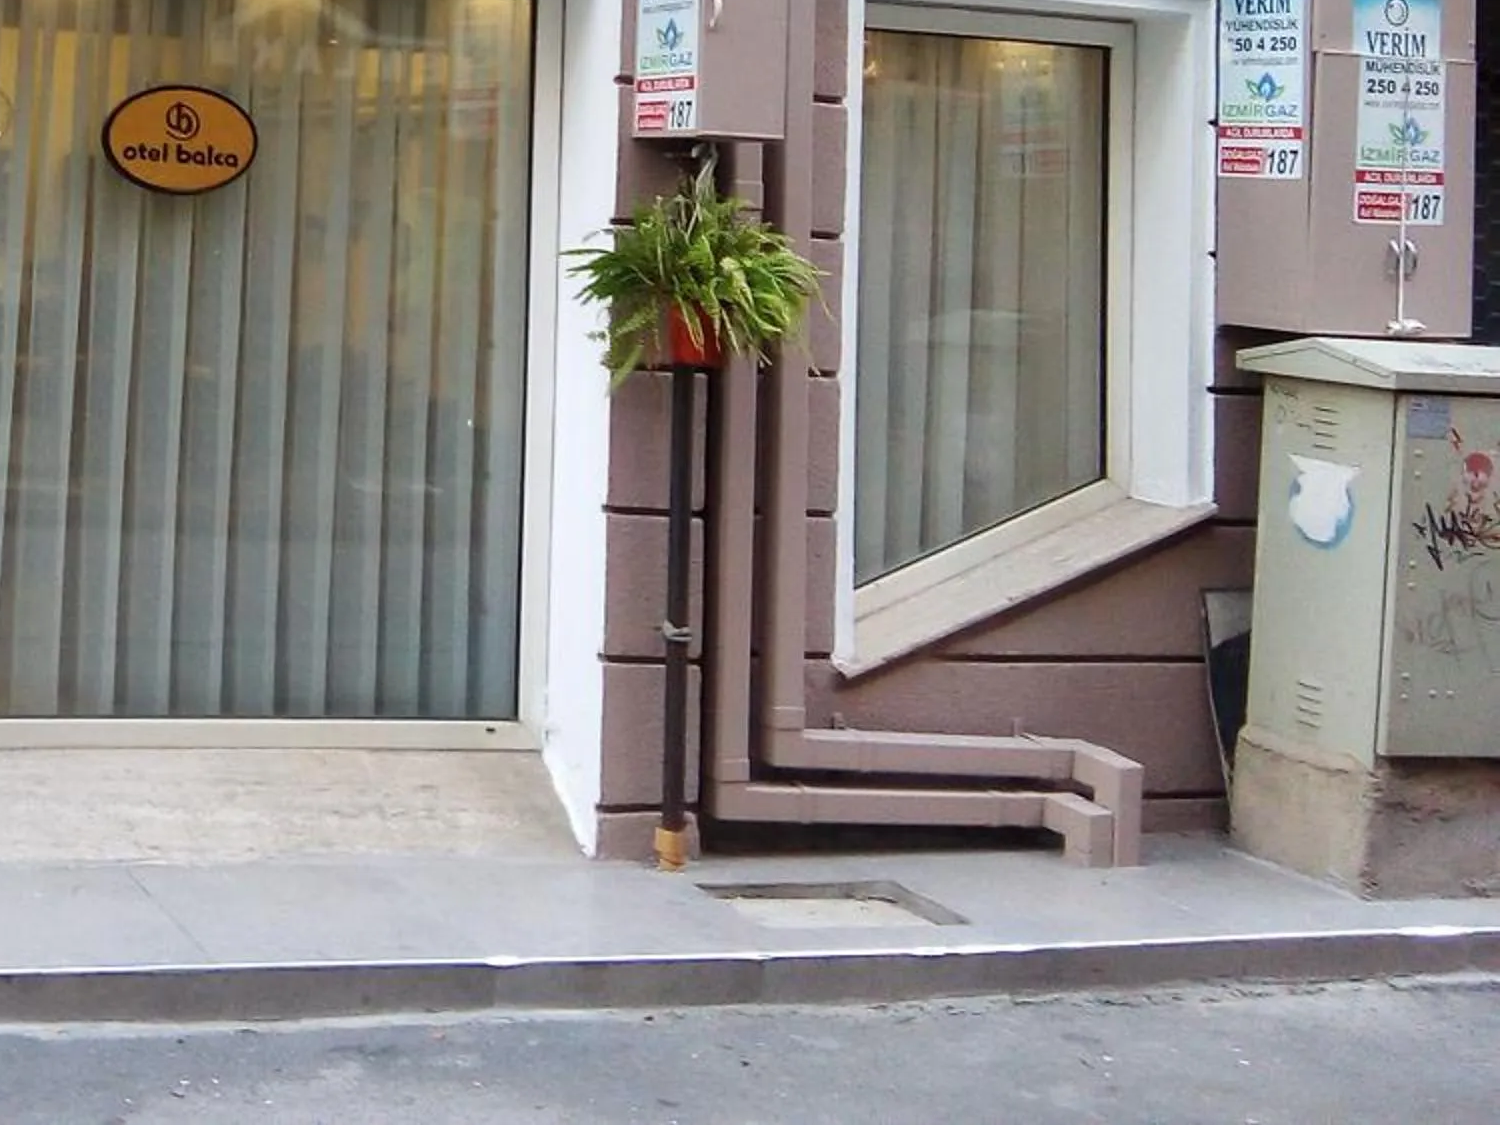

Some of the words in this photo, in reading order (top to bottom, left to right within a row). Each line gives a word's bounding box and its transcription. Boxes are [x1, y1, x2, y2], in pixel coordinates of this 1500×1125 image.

[1256, 36, 1265, 52] 4
[1270, 35, 1297, 52] 250
[1366, 26, 1426, 58] VERİM
[1366, 78, 1397, 94] 250
[1415, 80, 1440, 96] 250
[670, 99, 693, 128] 187
[123, 142, 169, 163] otel
[175, 143, 240, 168] balca
[1267, 148, 1299, 175] 187
[1411, 193, 1441, 221] 187
